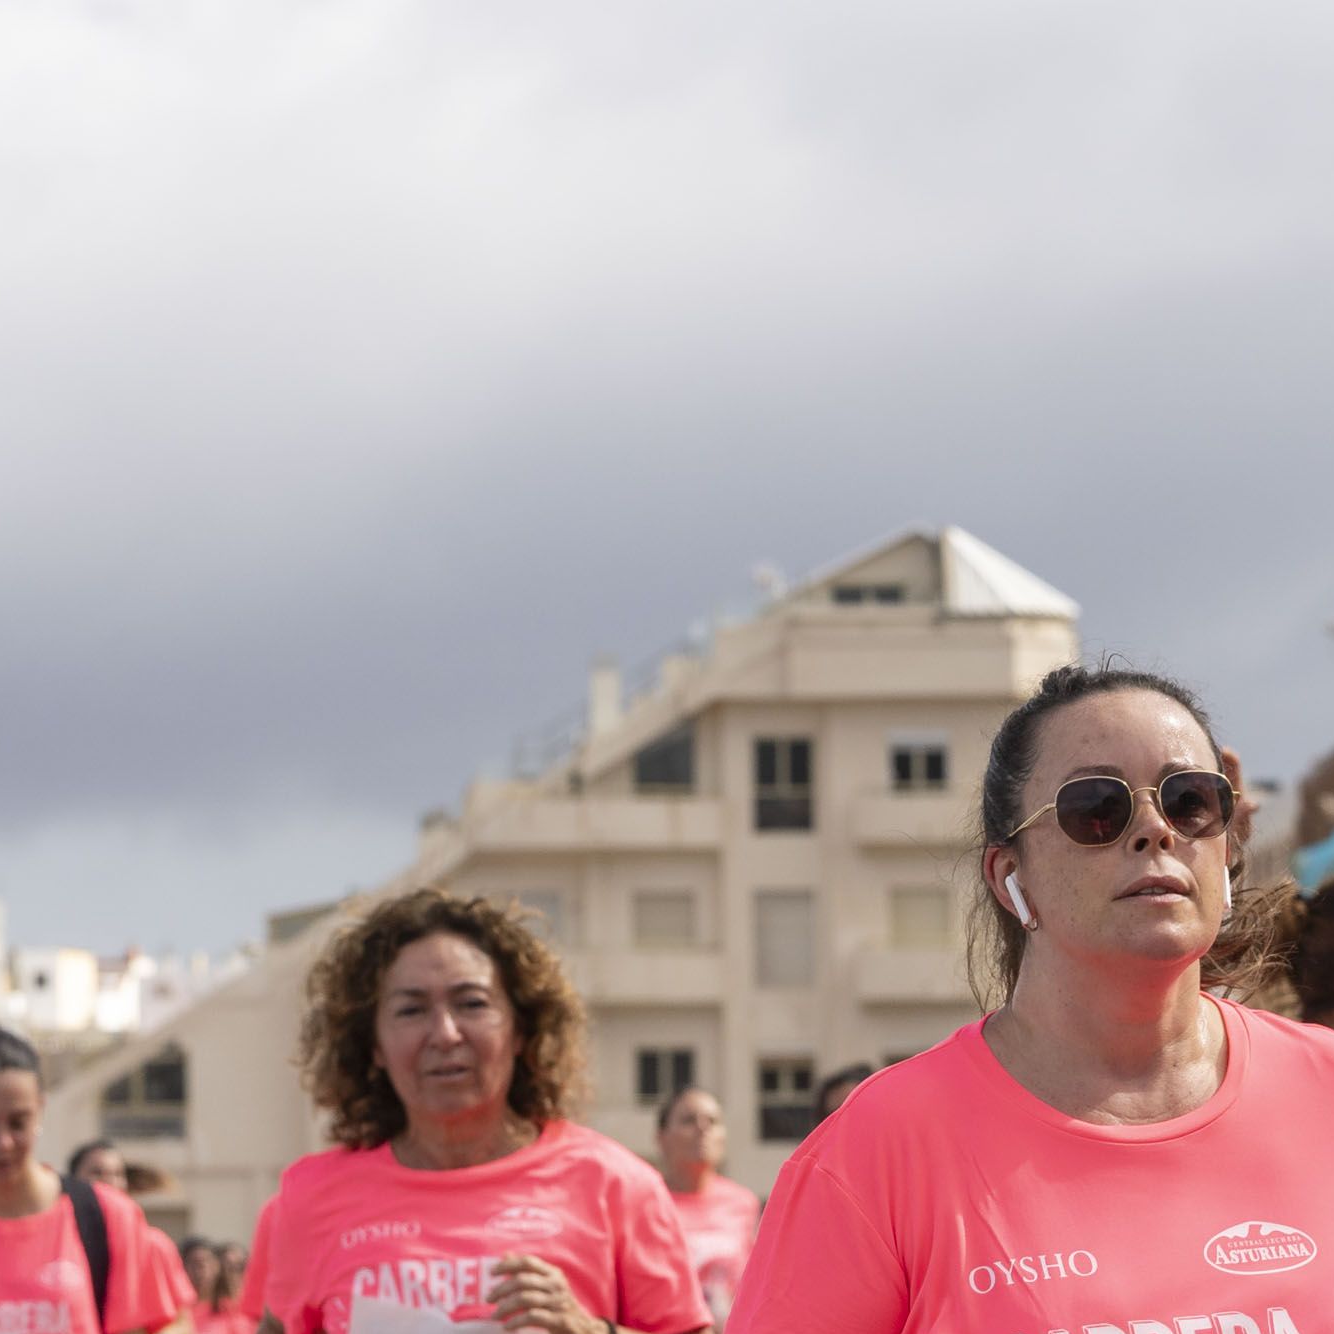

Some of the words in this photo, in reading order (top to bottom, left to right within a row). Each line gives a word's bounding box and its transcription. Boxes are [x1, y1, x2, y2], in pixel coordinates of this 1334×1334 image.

[969, 1250, 1098, 1294] OYSHO
[1215, 1243, 1311, 1265] ASTURIANA
[350, 1256, 503, 1313] CARRE
